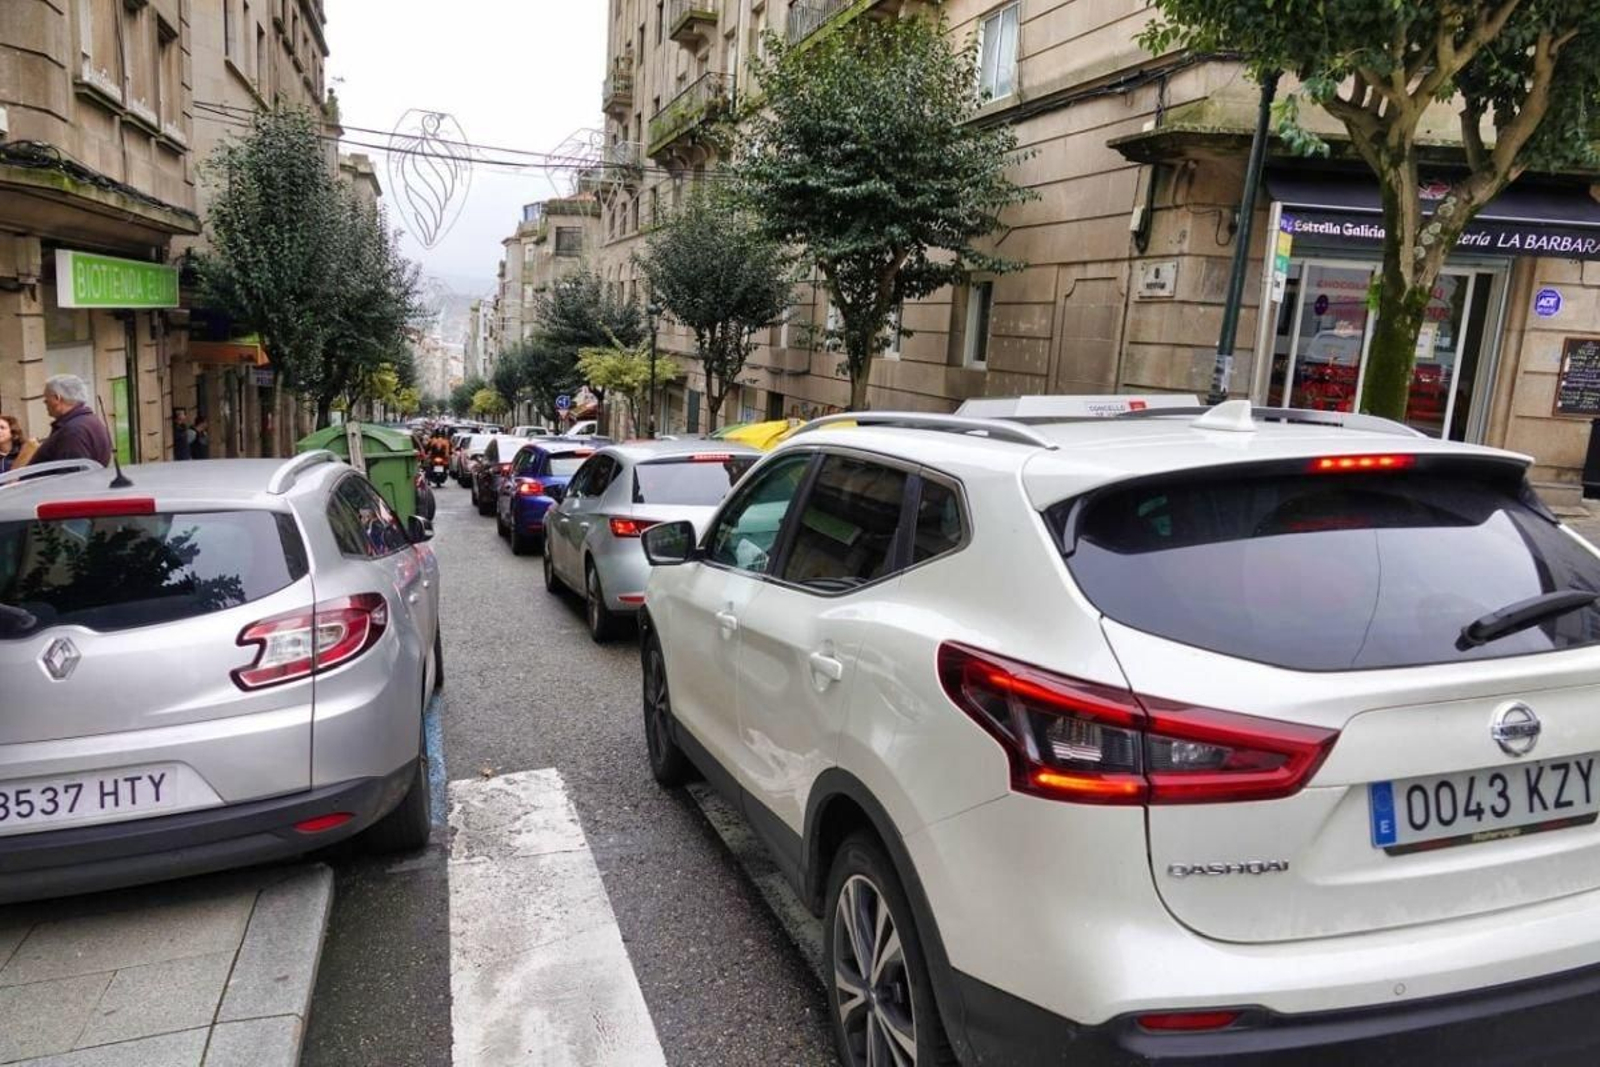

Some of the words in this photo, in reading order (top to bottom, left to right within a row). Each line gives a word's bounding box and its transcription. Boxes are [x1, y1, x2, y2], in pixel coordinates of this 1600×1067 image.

[1294, 219, 1341, 235] Estrella
[1342, 222, 1386, 239] Galicia
[1456, 230, 1491, 246] tería
[1497, 232, 1520, 248] LA
[76, 262, 145, 300] BIOTIENDA
[99, 772, 166, 809] HTY
[1406, 772, 1511, 831] 0043
[1525, 757, 1594, 814] KZY
[1379, 820, 1390, 834] E
